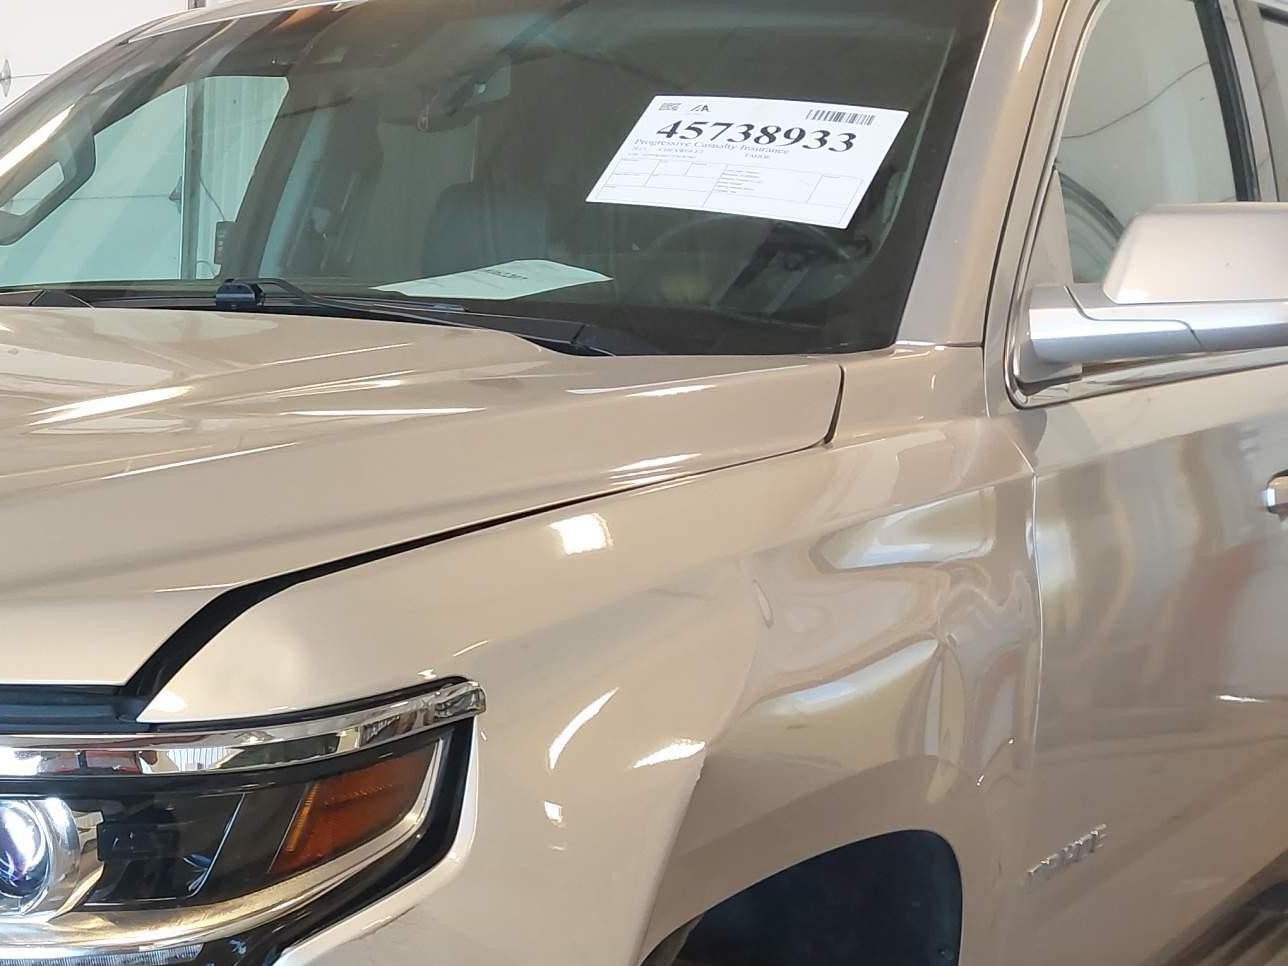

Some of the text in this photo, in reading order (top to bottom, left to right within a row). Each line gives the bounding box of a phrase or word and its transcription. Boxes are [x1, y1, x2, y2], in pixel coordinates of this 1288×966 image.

[633, 138, 692, 149] Progressive
[694, 141, 738, 151] Casualty
[739, 144, 791, 155] Insurance
[656, 119, 858, 153] 45738933
